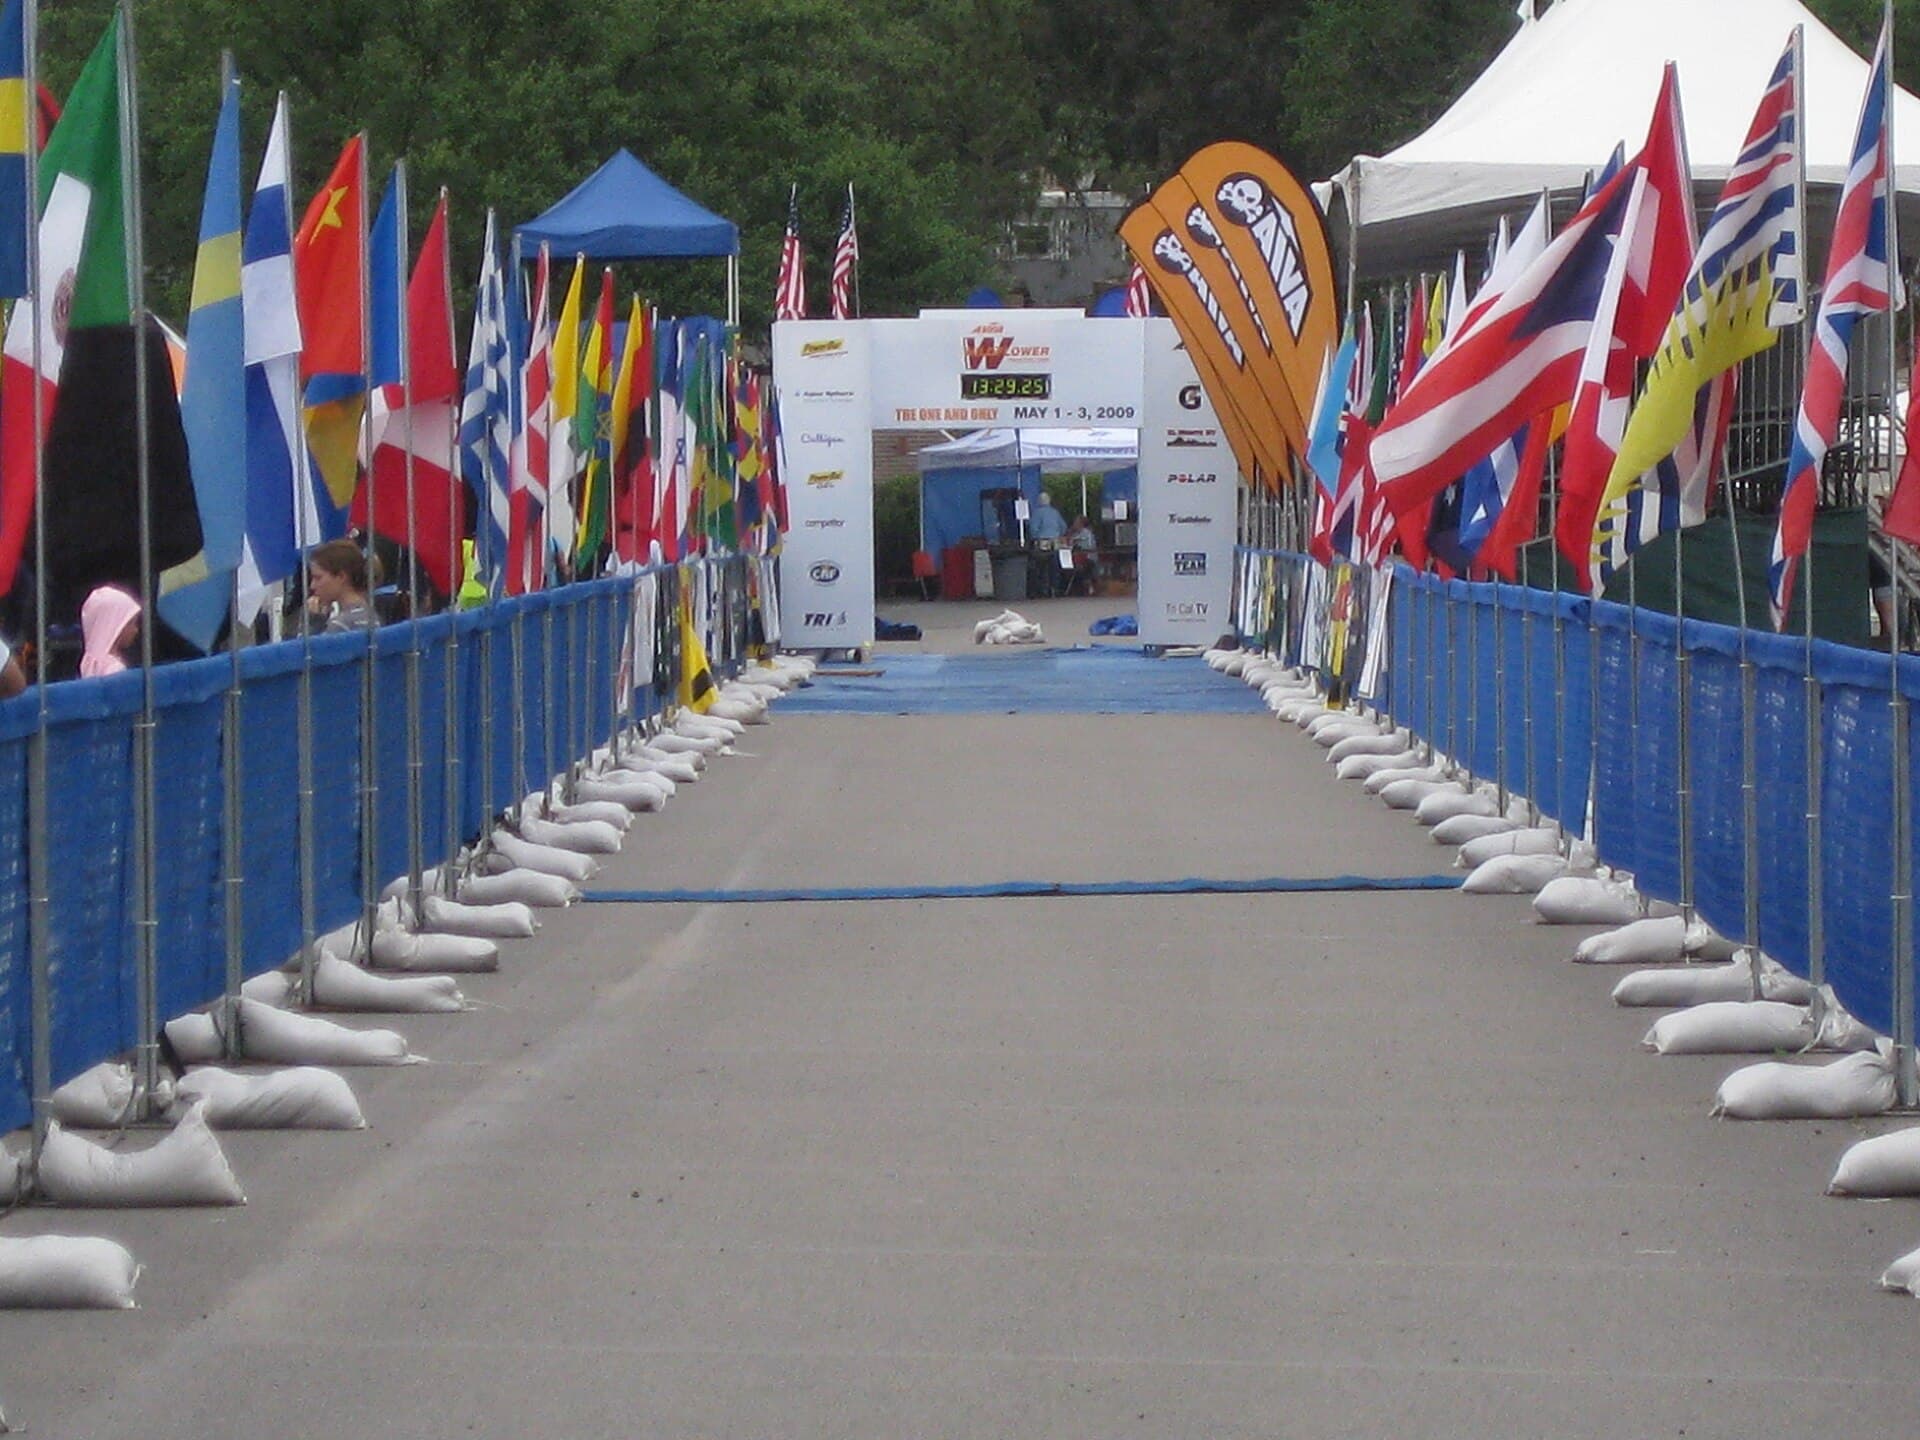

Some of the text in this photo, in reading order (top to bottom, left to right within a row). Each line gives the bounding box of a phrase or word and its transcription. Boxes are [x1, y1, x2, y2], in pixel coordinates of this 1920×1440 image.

[896, 408, 916, 421] THE
[919, 408, 942, 421] ONE
[944, 408, 968, 421] AND
[1014, 407, 1047, 419] MAY
[1054, 407, 1061, 419] 1
[1078, 407, 1092, 421] 3,
[1096, 407, 1135, 419] 2009
[1167, 474, 1216, 483] POLAR
[1196, 603, 1209, 614] TV
[804, 613, 833, 626] TRI
